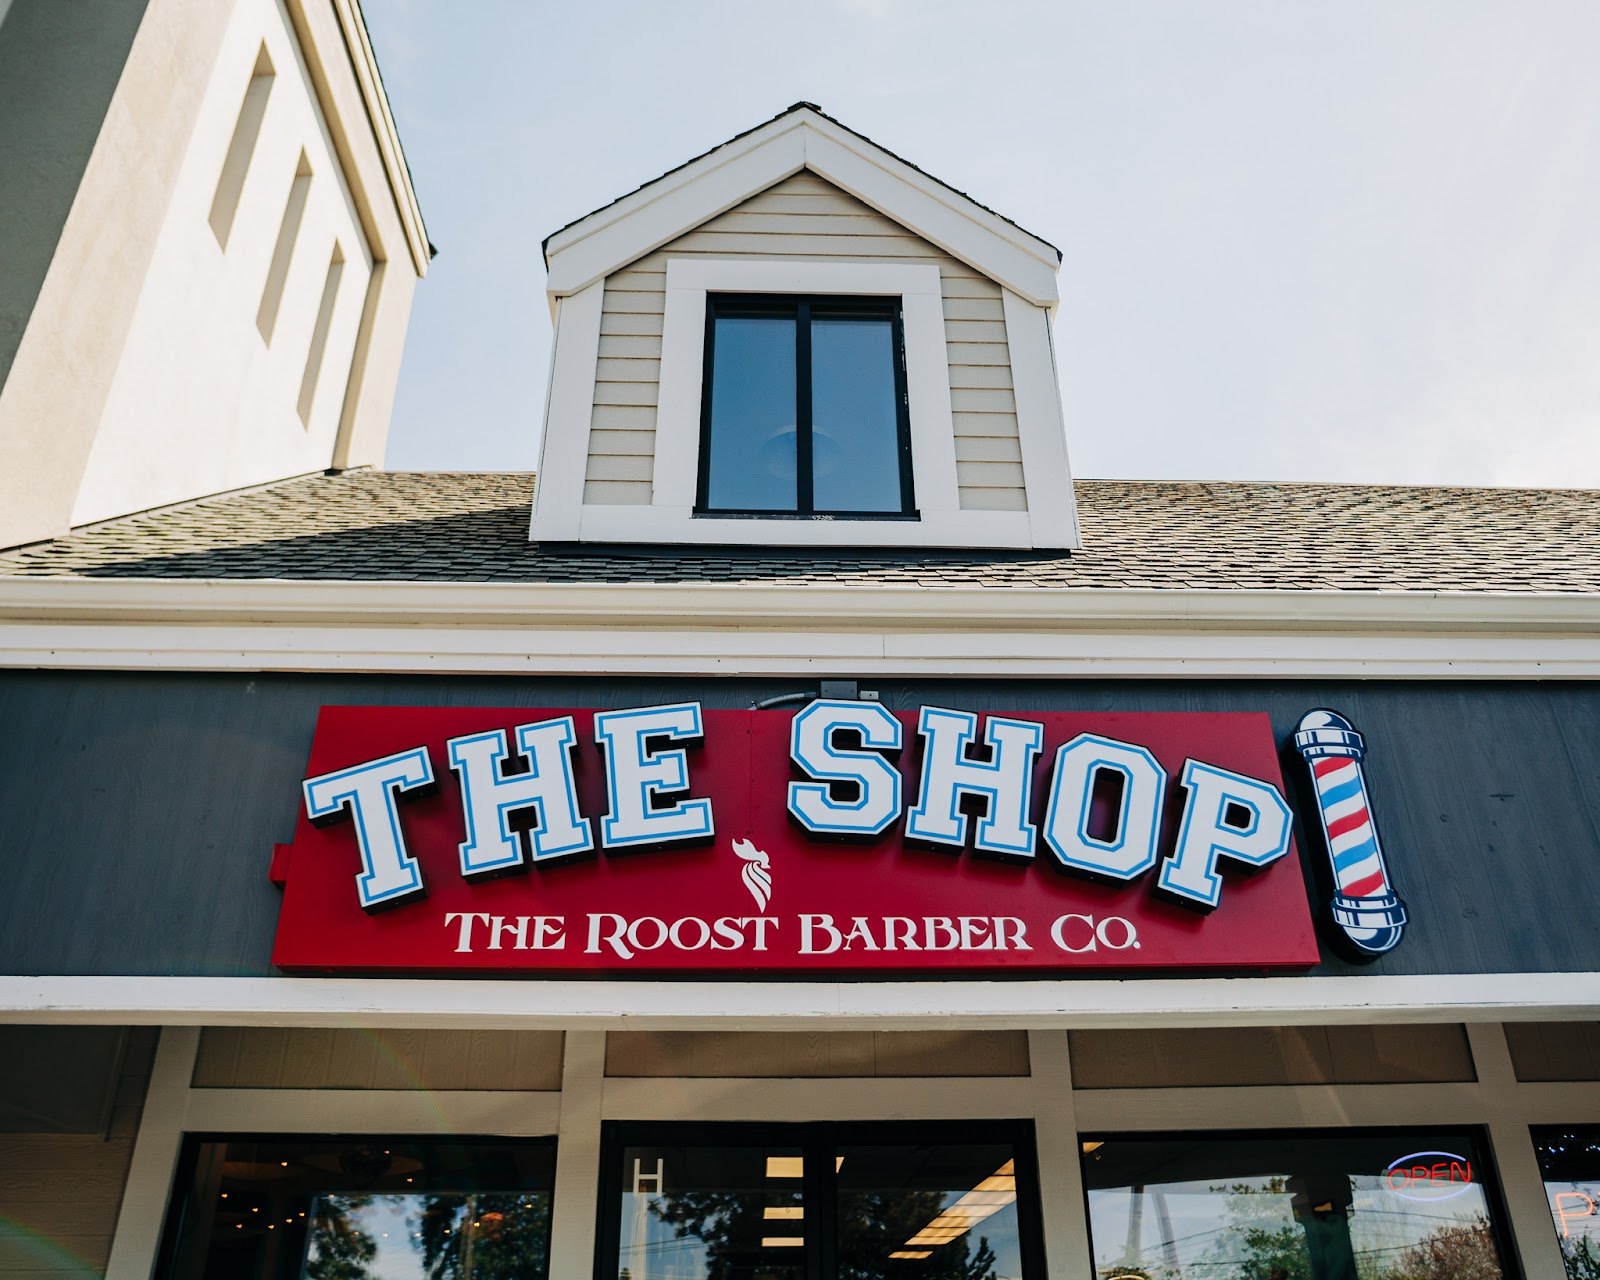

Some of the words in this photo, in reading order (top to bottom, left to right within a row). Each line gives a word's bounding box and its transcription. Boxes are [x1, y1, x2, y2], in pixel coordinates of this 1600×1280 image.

[302, 701, 716, 909] THE
[786, 698, 1295, 908] SHOP
[444, 912, 566, 953] THE
[583, 913, 780, 960] ROOST
[797, 913, 1034, 955] BARBER
[1050, 913, 1142, 953] CO.
[1387, 1161, 1472, 1191] OPEN
